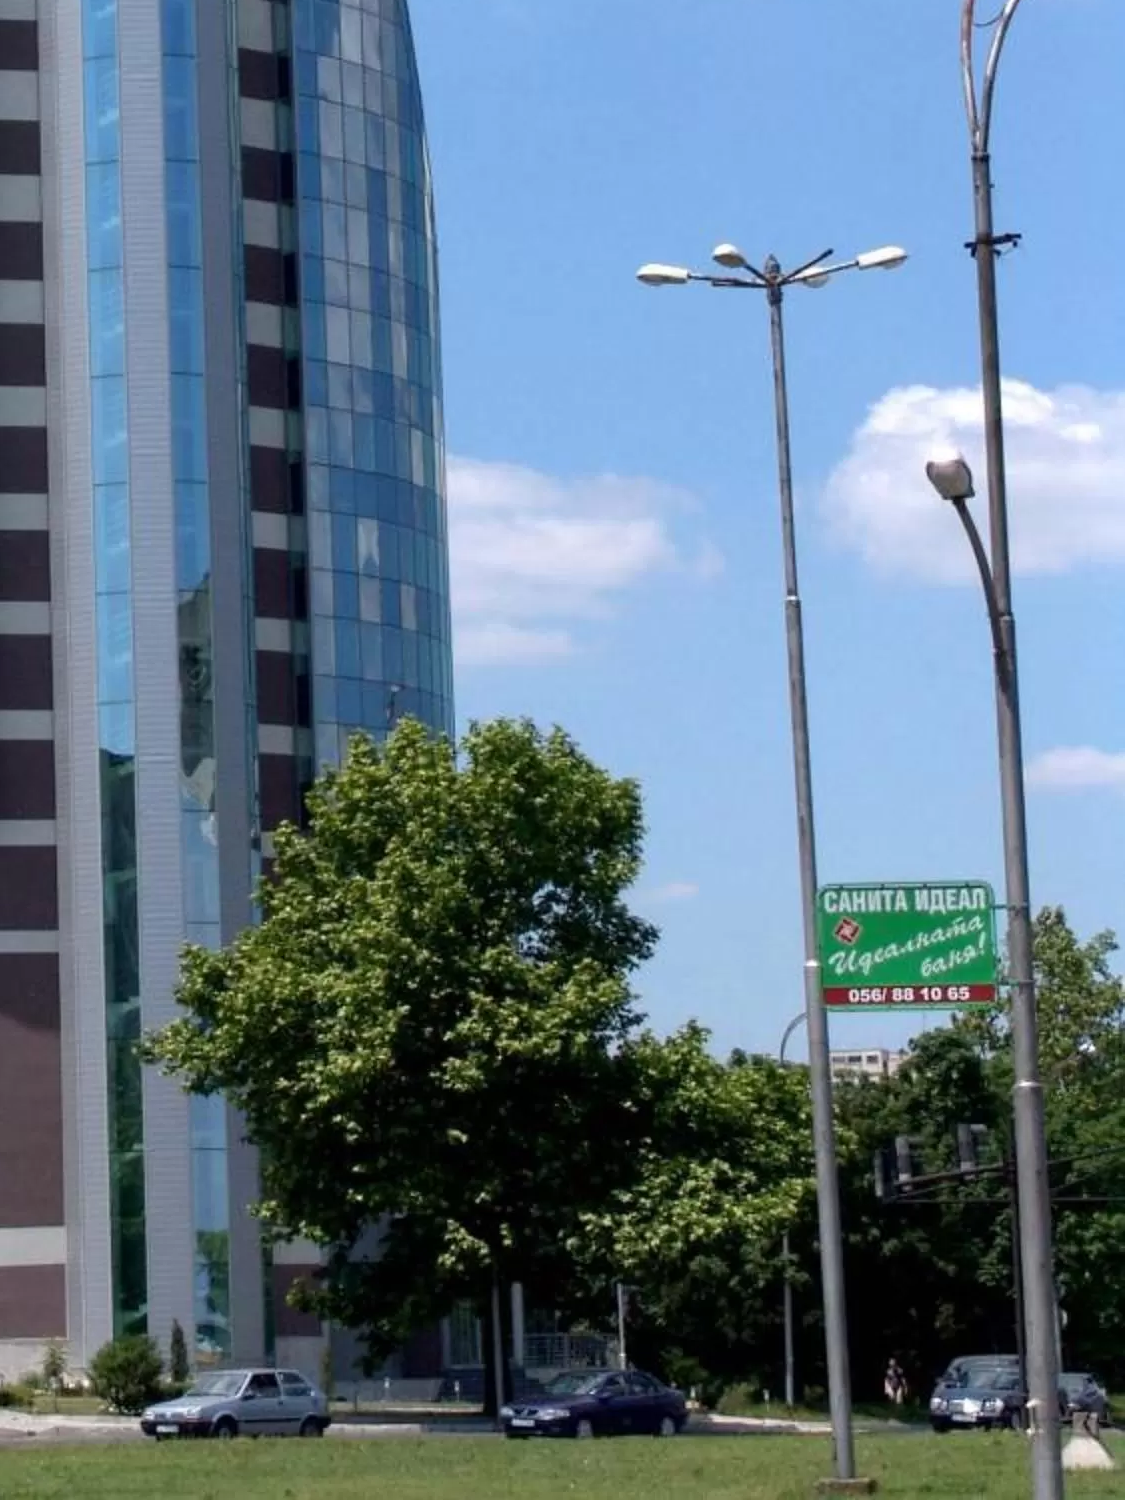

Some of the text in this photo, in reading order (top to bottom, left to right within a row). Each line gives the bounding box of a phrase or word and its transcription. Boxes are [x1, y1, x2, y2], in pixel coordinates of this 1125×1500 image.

[825, 888, 986, 914] САНИТА ИДЕАЛ
[848, 986, 970, 1003] 056/ 88 10 65
